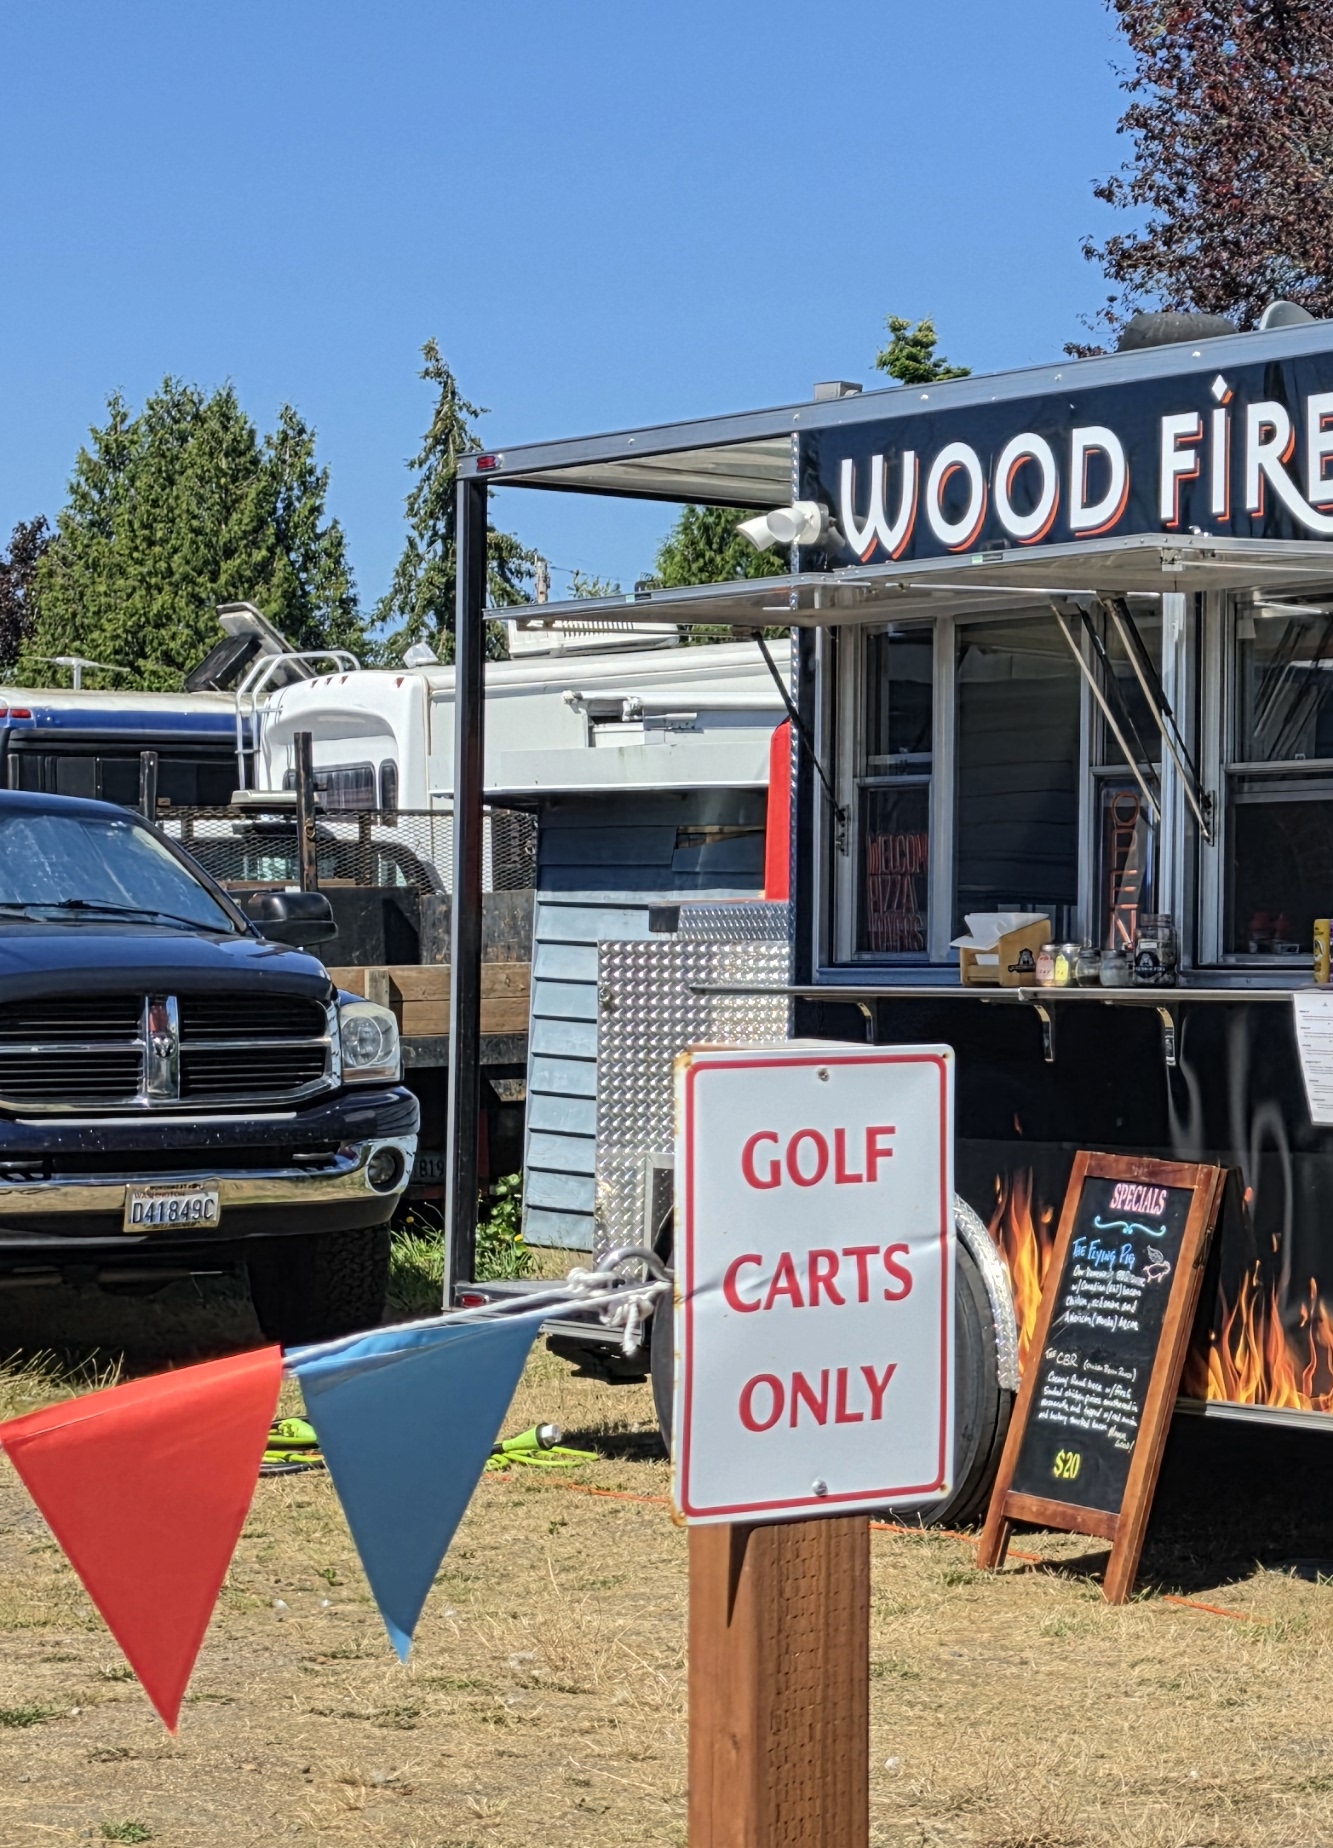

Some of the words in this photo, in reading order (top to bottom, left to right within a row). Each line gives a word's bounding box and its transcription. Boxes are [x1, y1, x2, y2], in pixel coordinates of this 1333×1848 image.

[839, 426, 1130, 561] WOOD
[868, 833, 928, 875] WELCOM
[741, 1126, 897, 1190] GOLF
[132, 1197, 216, 1224] D41849C
[1109, 1183, 1168, 1216] SPECIALS
[1073, 1236, 1087, 1259] THE
[1087, 1239, 1116, 1271] FLYING
[1119, 1243, 1136, 1271] PIG
[723, 1243, 913, 1313] CARTS
[1056, 1352, 1078, 1367] CBR
[738, 1362, 898, 1433] ONLY
[1053, 1449, 1081, 1479] $20
